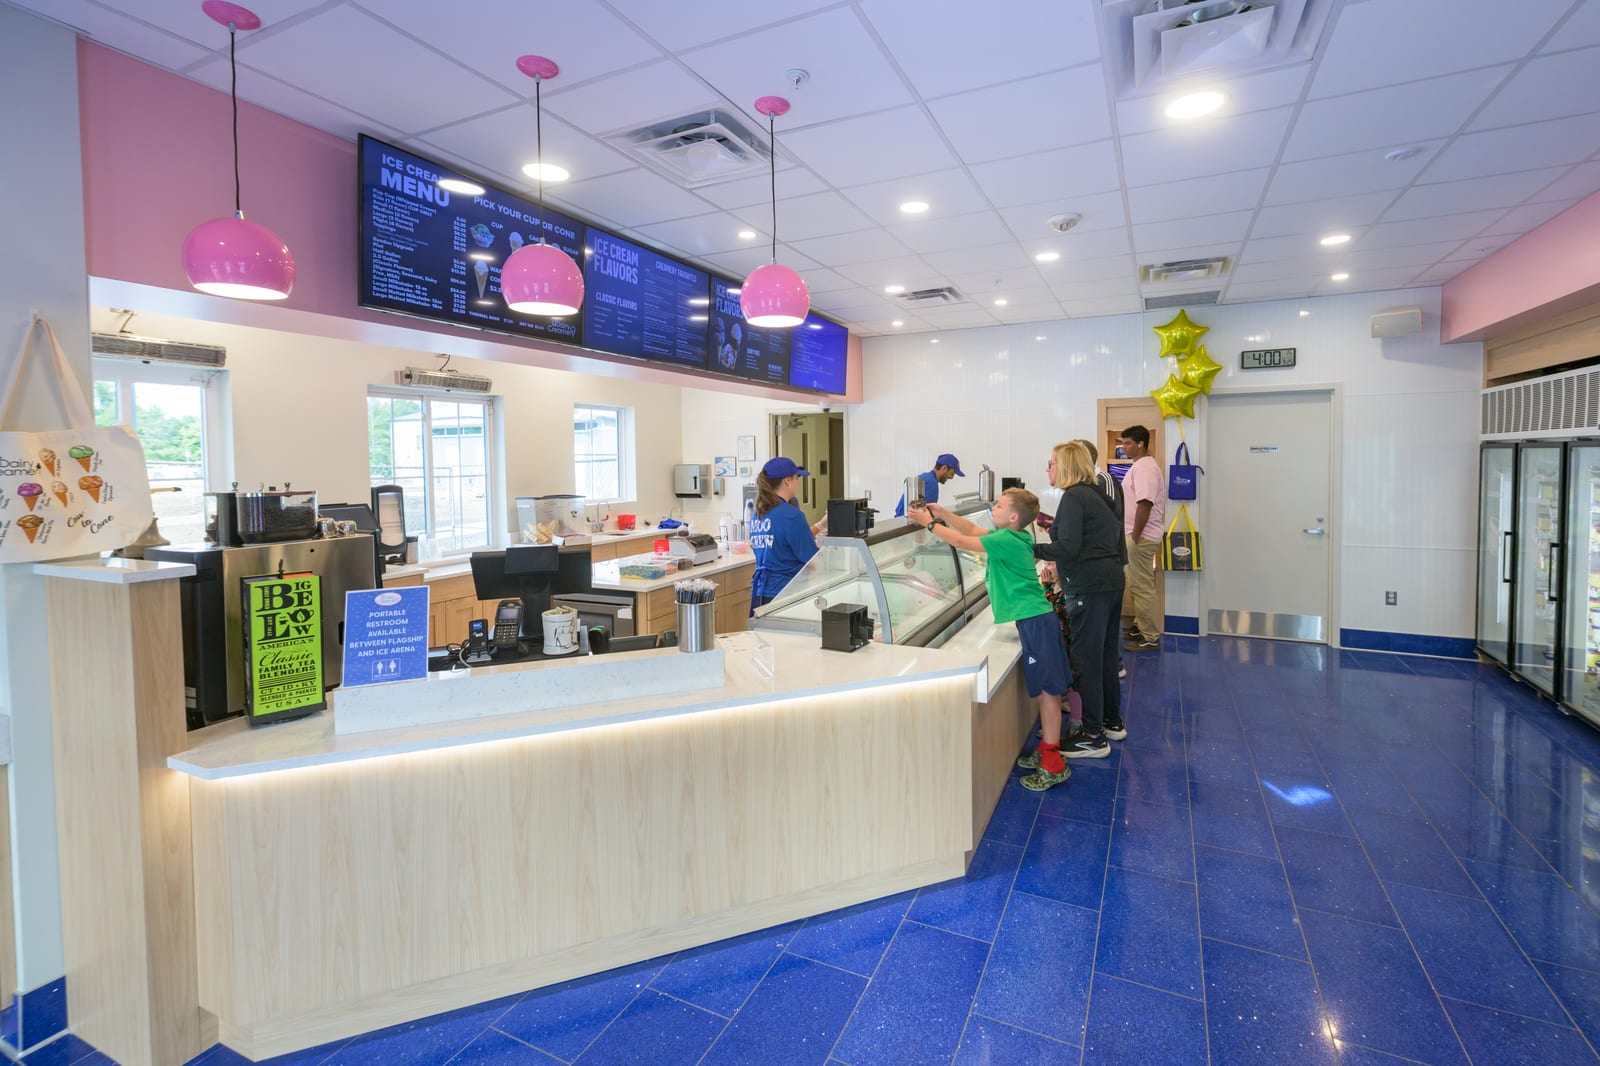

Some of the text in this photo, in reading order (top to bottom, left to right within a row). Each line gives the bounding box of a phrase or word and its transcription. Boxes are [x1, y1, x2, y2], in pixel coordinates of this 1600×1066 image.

[382, 153, 446, 183] ICE CREA
[381, 167, 450, 207] MENU
[473, 196, 577, 239] PICK YOUR CUP OR CONE
[491, 221, 504, 230] CUP
[563, 246, 579, 256] SUGAR
[594, 237, 638, 267] ICE CREAM
[594, 255, 638, 285] FLAVORS
[716, 284, 726, 298] ICE
[596, 291, 638, 311] CLASSIC FLAVORS
[1252, 351, 1281, 366] 4:00
[67, 511, 84, 528] Cow
[81, 518, 92, 528] to
[90, 515, 114, 534] Cone
[369, 609, 407, 618] PORTABLE
[366, 618, 409, 628] RESTROOM
[368, 627, 407, 637] AVAILABLE
[259, 637, 314, 651] AMERICA'S
[349, 635, 424, 649] BETWEEN FLAGSHIP
[376, 648, 388, 656] ICE
[390, 646, 416, 654] ARENA
[259, 650, 313, 667] Classic
[259, 659, 315, 673] FAMILY TEA
[259, 666, 316, 679] BLENDERS
